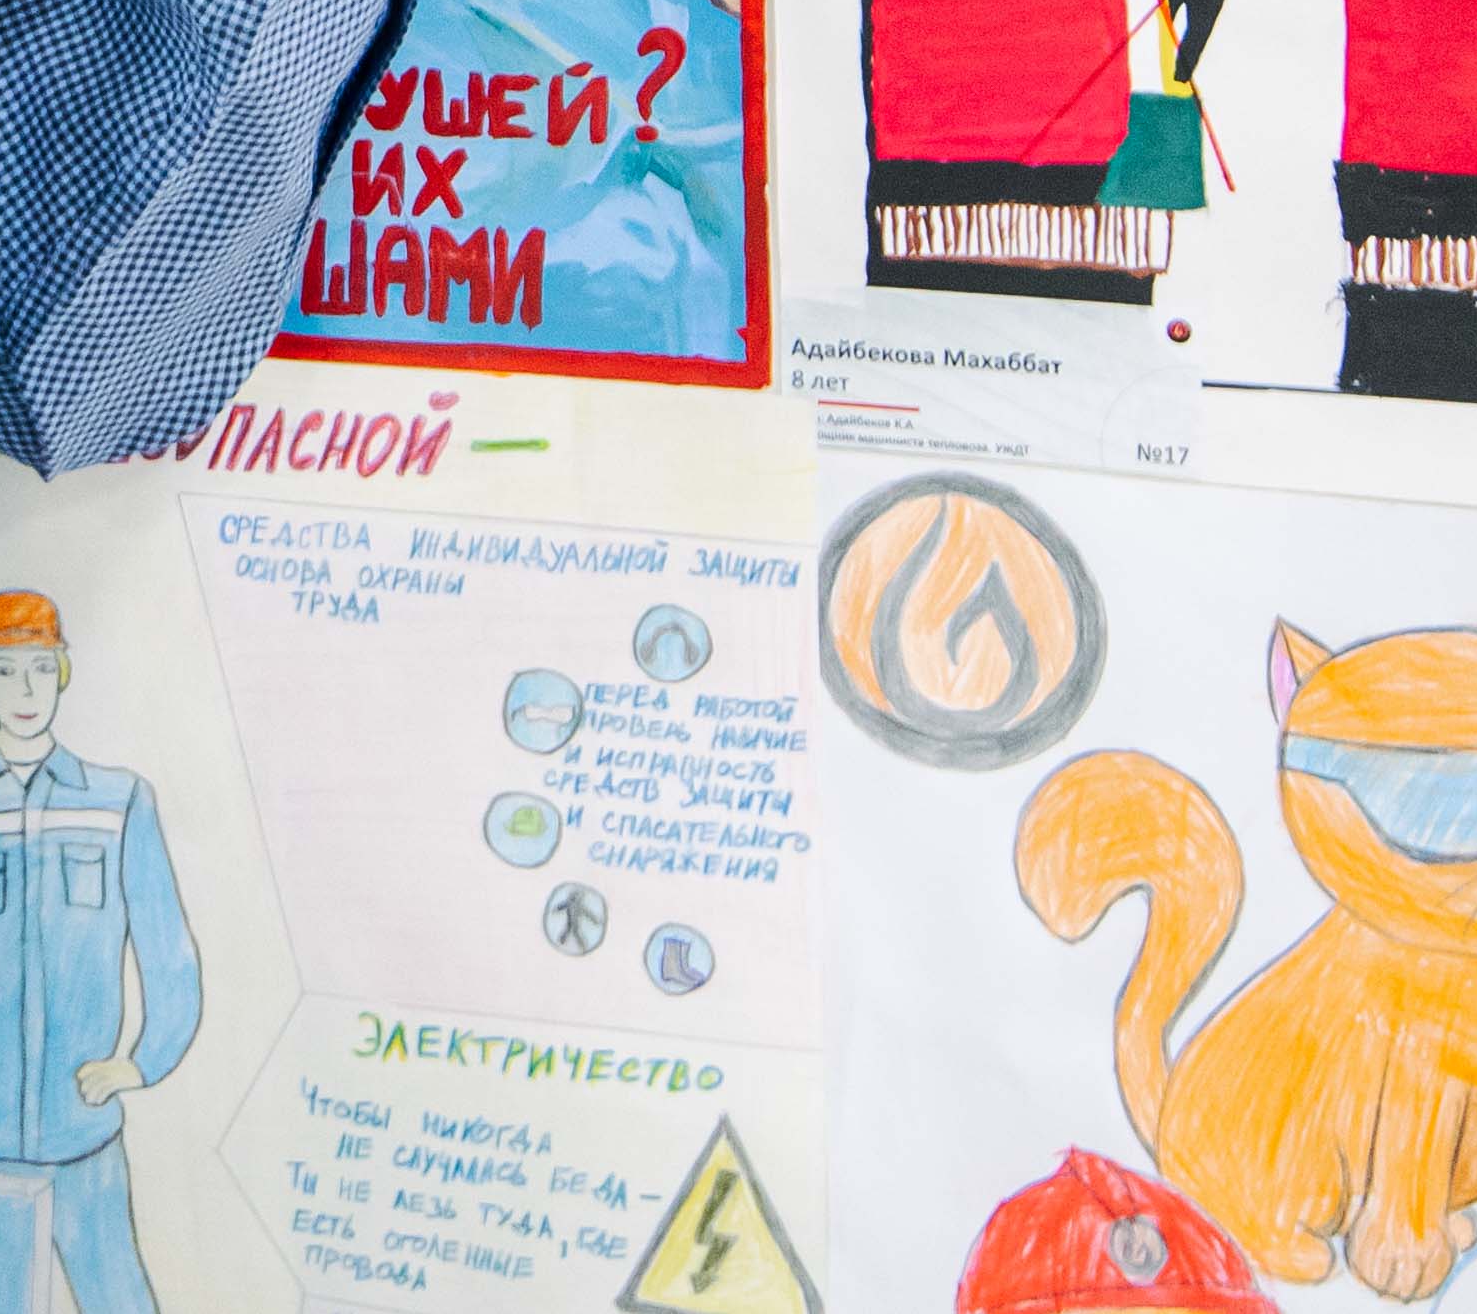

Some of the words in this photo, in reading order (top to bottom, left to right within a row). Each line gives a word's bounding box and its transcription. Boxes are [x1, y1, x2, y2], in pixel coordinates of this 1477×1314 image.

[790, 337, 936, 366] Адайбекова
[943, 347, 1064, 375] Махаббат
[791, 370, 805, 389] 8
[811, 372, 851, 392] лет
[1136, 442, 1190, 465] №17
[219, 513, 372, 553] СРЕДСТВА
[409, 525, 669, 574] ИНДИВИДУАЛЬНОЙ
[689, 548, 801, 588] ЗАЩИТЫ
[235, 554, 332, 585] ОСНОВА
[358, 565, 466, 597] ОХРАНЫ
[291, 590, 381, 624] ТРУДА
[585, 683, 670, 711] ПЕРЕД
[694, 694, 798, 724] РАБОТОЙ
[543, 769, 660, 804] СРЕДСТВ
[353, 1011, 725, 1094] ЭЛЕКТРИЧЕСТВО
